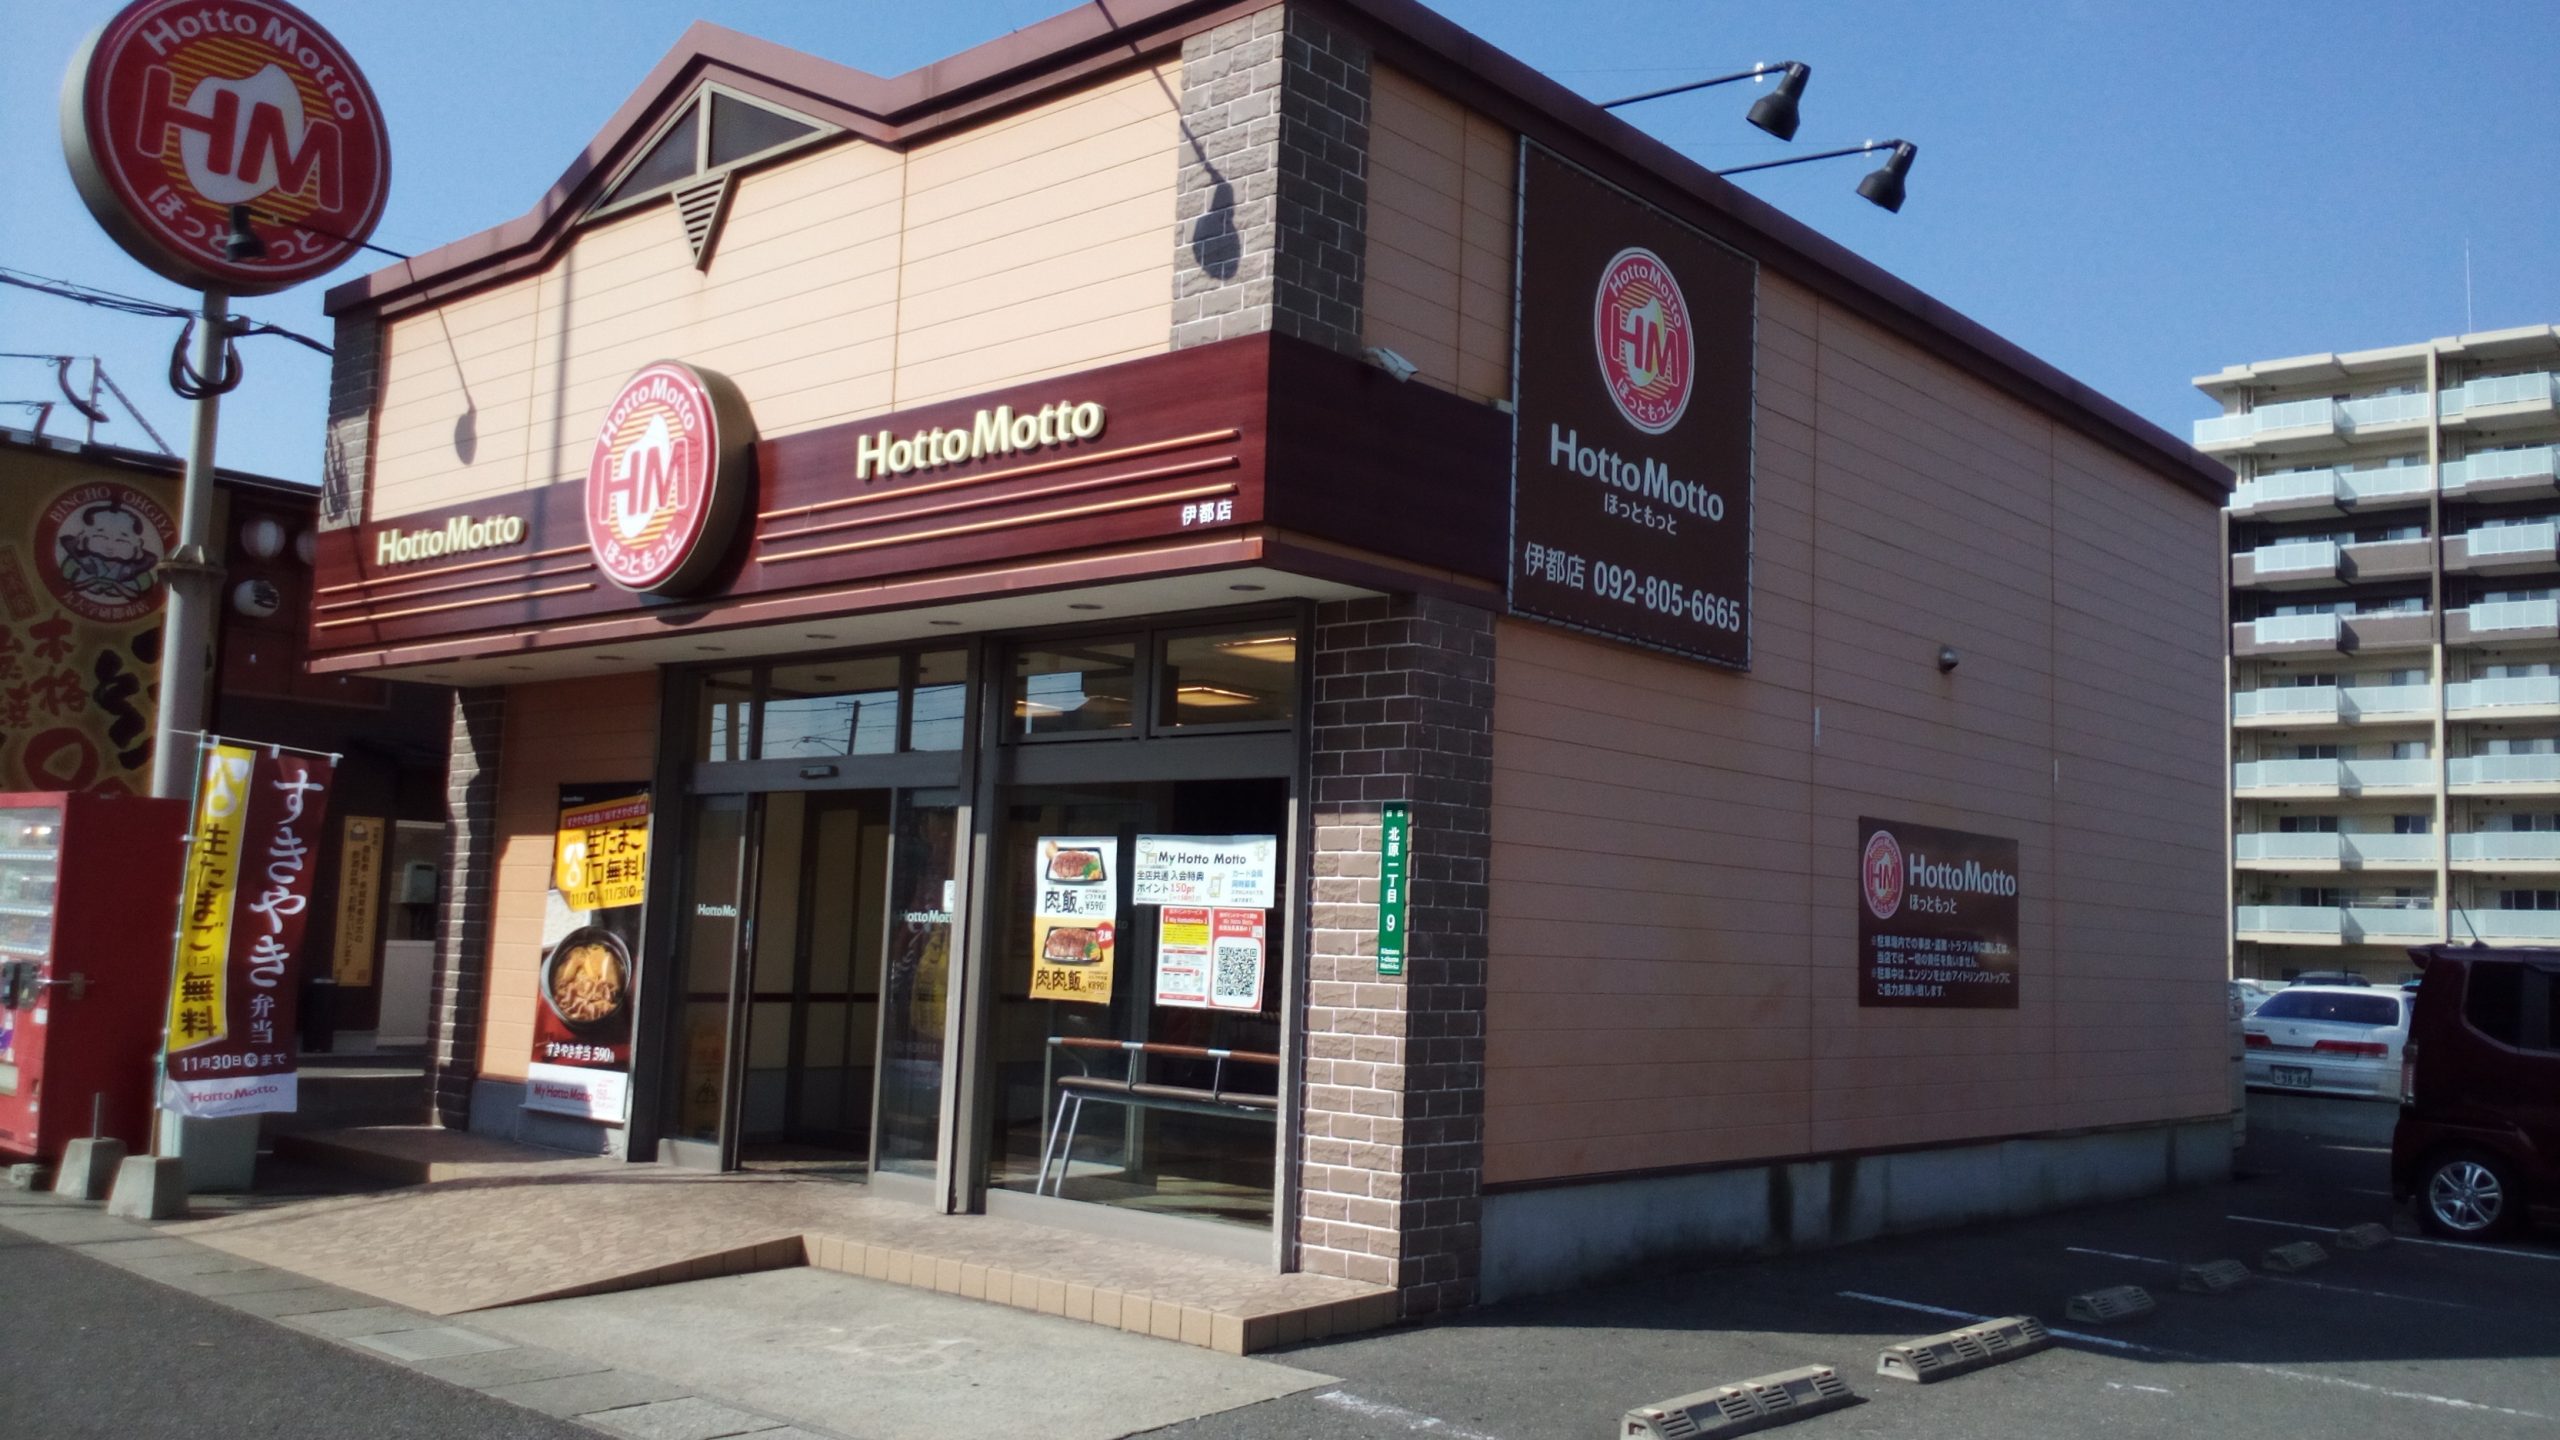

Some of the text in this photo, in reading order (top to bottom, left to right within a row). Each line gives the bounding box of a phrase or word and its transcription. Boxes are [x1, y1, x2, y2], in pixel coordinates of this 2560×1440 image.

[147, 185, 325, 260] ほっとっと
[1616, 376, 1675, 422] ほっともっと
[856, 400, 1106, 480] HottoMotto
[50, 487, 111, 523] BINCHO
[1182, 500, 1233, 526] 伊都店
[1604, 493, 1677, 536] ほっともっと
[377, 514, 526, 567] HottoMotto
[604, 531, 681, 577] ほっともっと
[1524, 541, 1741, 633] 伊都店 092-805-6665
[1158, 851, 1247, 867] My Hotto Motto
[1386, 827, 1400, 932] 北原一丁目 9
[1909, 852, 2016, 896] HottoMotto
[1909, 894, 1957, 914] ほっともっと
[189, 1085, 278, 1103] HottoMotto
